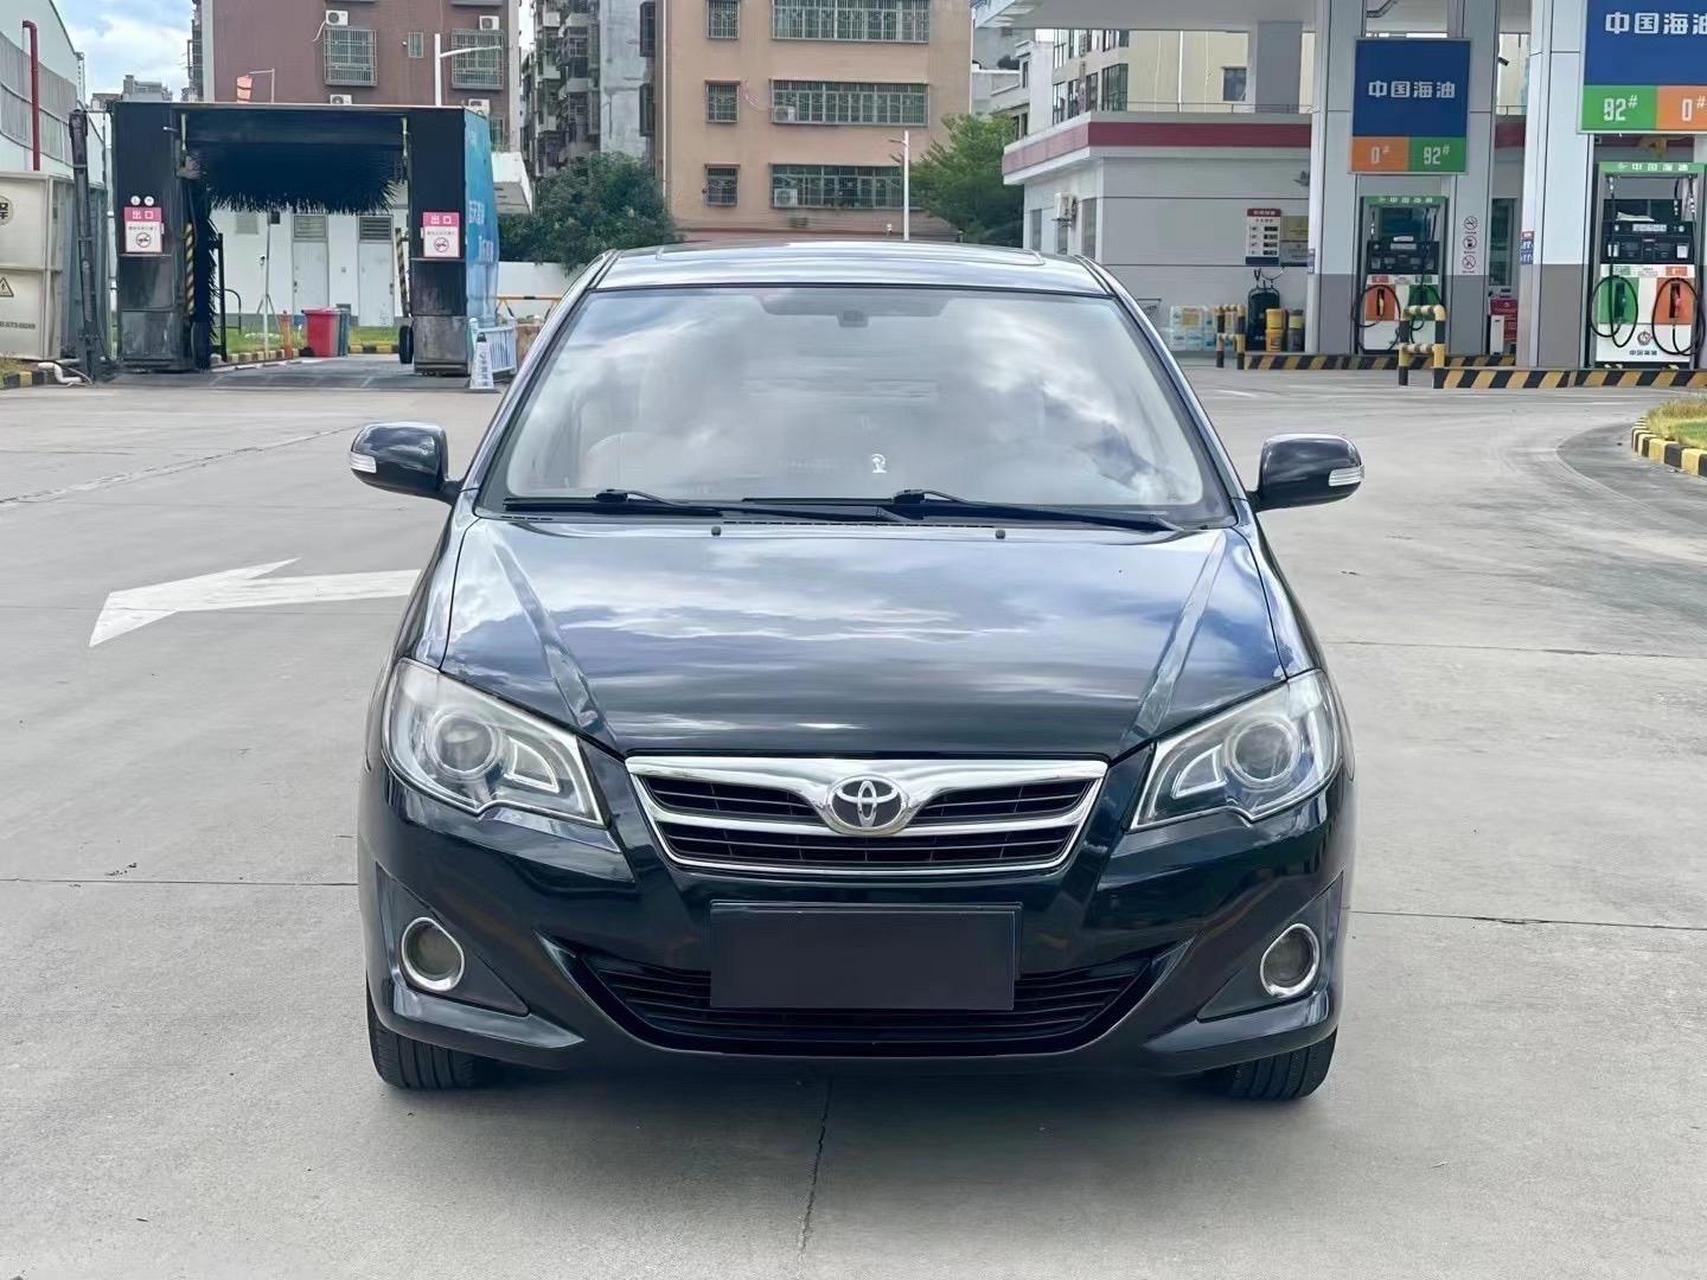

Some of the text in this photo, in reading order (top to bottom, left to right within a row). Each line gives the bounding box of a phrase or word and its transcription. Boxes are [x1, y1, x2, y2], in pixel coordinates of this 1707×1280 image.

[1605, 11, 1707, 35] 中国海油
[1368, 80, 1456, 98] 中国海油
[1603, 95, 1638, 121] 92#
[1423, 144, 1450, 165] 92#
[132, 210, 154, 220] 出口
[431, 214, 452, 225] 出口
